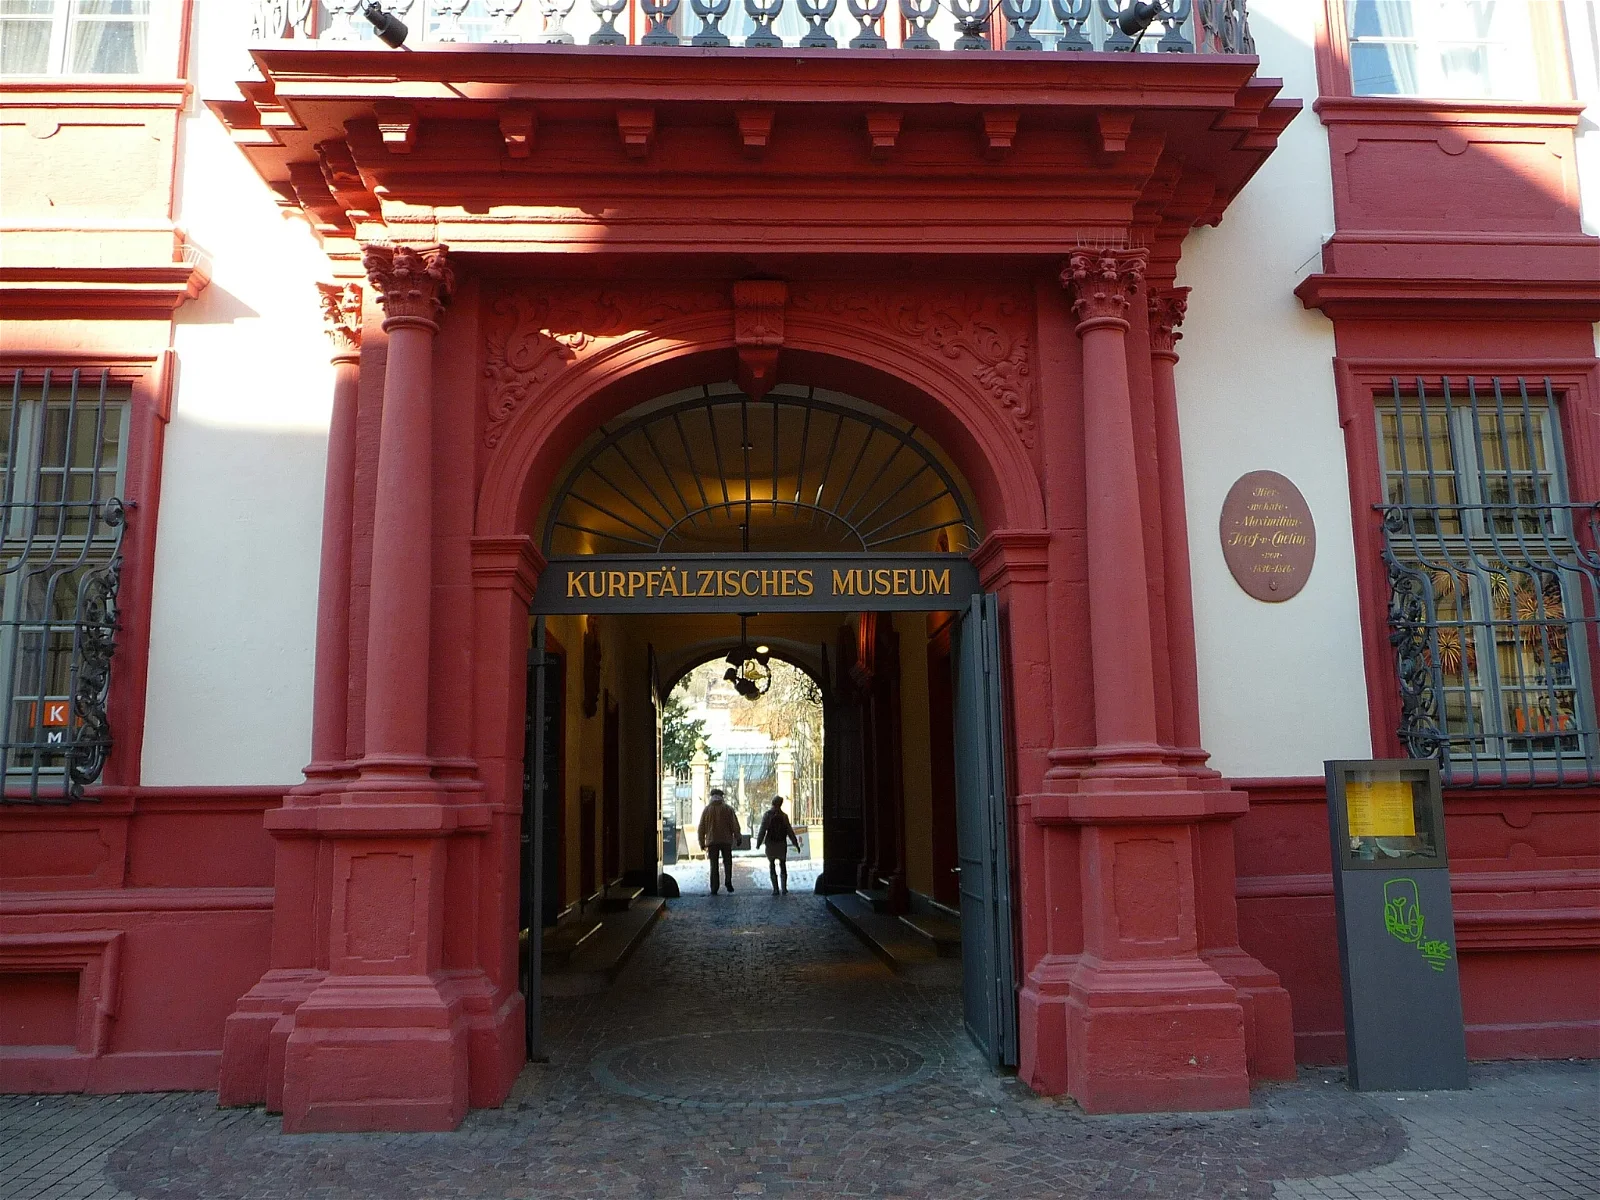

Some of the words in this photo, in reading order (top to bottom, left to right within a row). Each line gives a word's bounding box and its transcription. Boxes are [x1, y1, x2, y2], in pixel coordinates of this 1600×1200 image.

[1253, 487, 1276, 497] Hier
[1250, 503, 1284, 511] wohnte
[1242, 515, 1298, 528] Maximilian
[1228, 531, 1259, 548] Josef
[1271, 530, 1307, 548] Chelius
[566, 566, 814, 598] KURPFÄLZISCHES
[831, 568, 951, 596] MUSEUM
[50, 705, 64, 722] K
[47, 731, 62, 748] M
